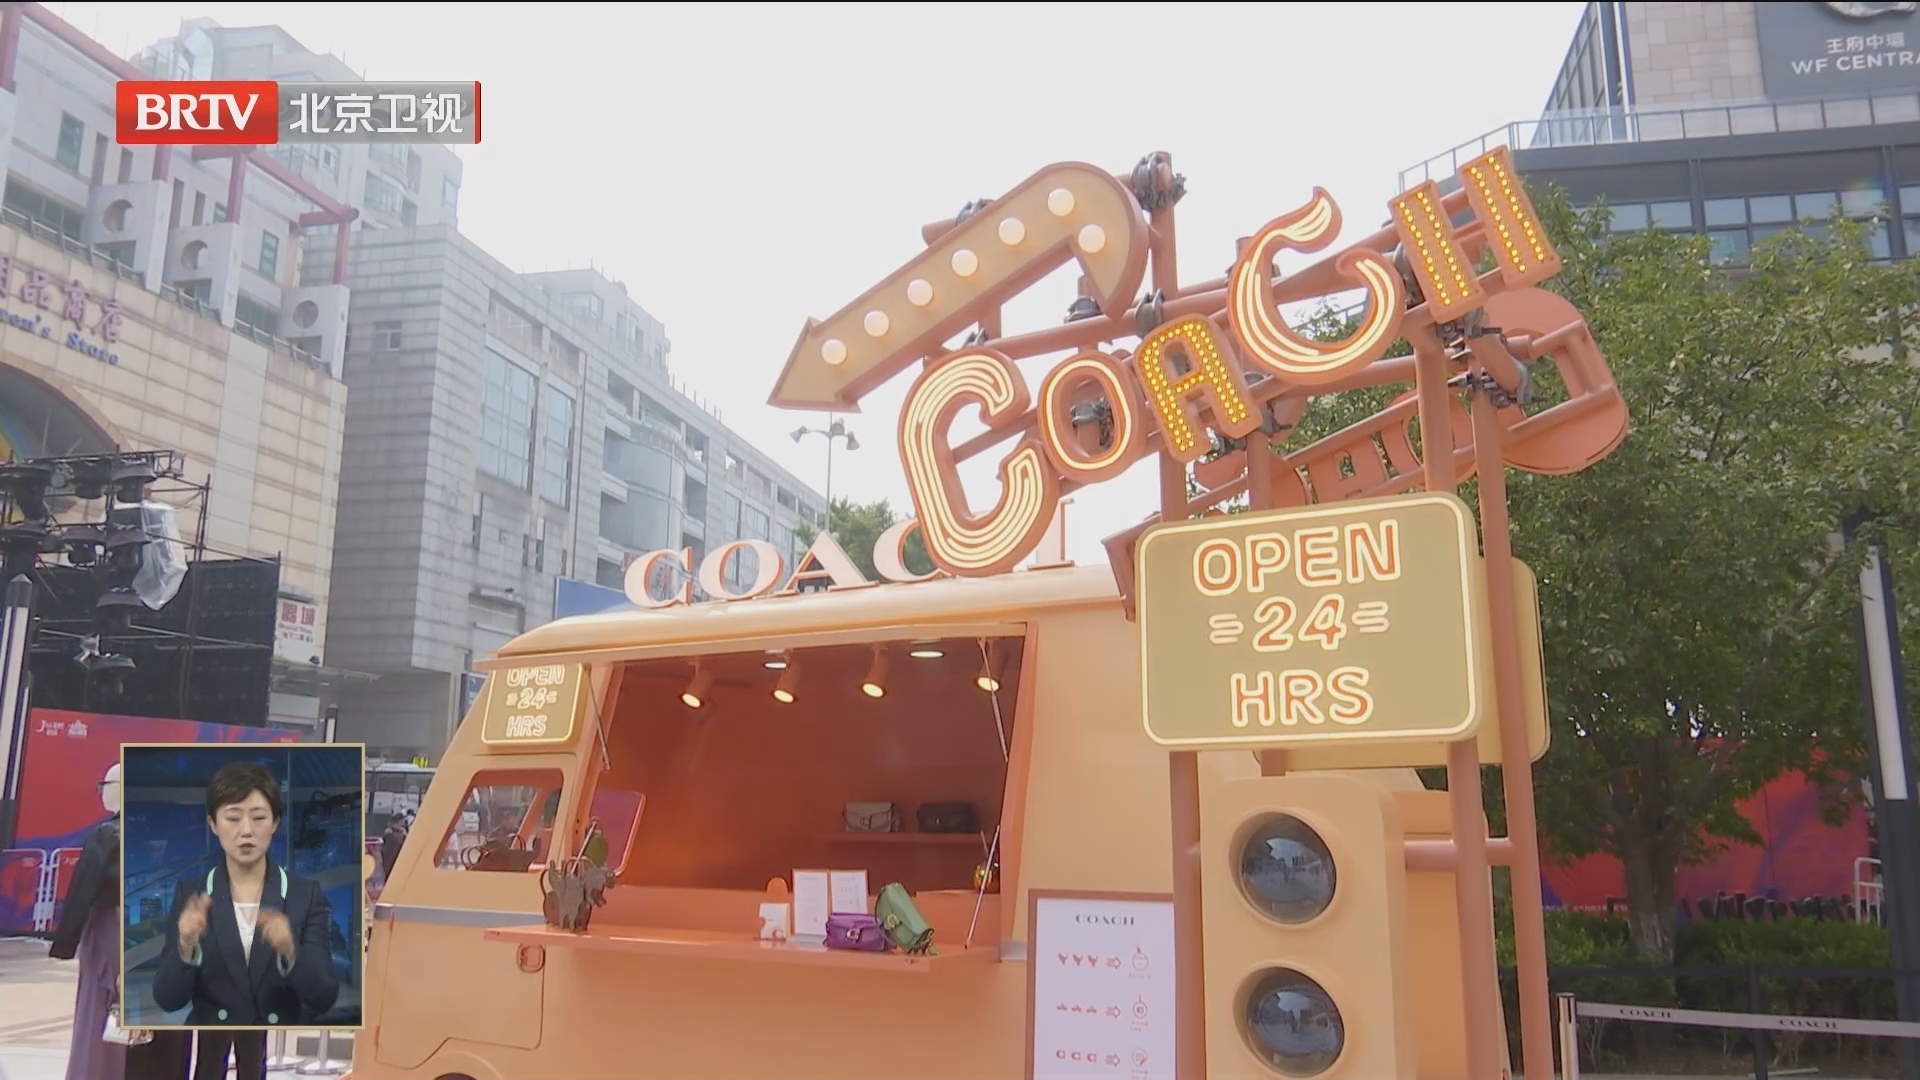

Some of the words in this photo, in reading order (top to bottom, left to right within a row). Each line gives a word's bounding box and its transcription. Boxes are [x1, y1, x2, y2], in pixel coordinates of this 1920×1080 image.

[1791, 57, 1829, 75] WF
[897, 145, 1562, 577] COACH
[1192, 519, 1401, 597] OPEN
[506, 664, 566, 687] OPEN
[1230, 666, 1374, 727] HRS
[505, 714, 548, 738] HRS
[1075, 914, 1136, 927] COACH
[1619, 1008, 1672, 1019] COACH
[1779, 1018, 1838, 1030] COACH
